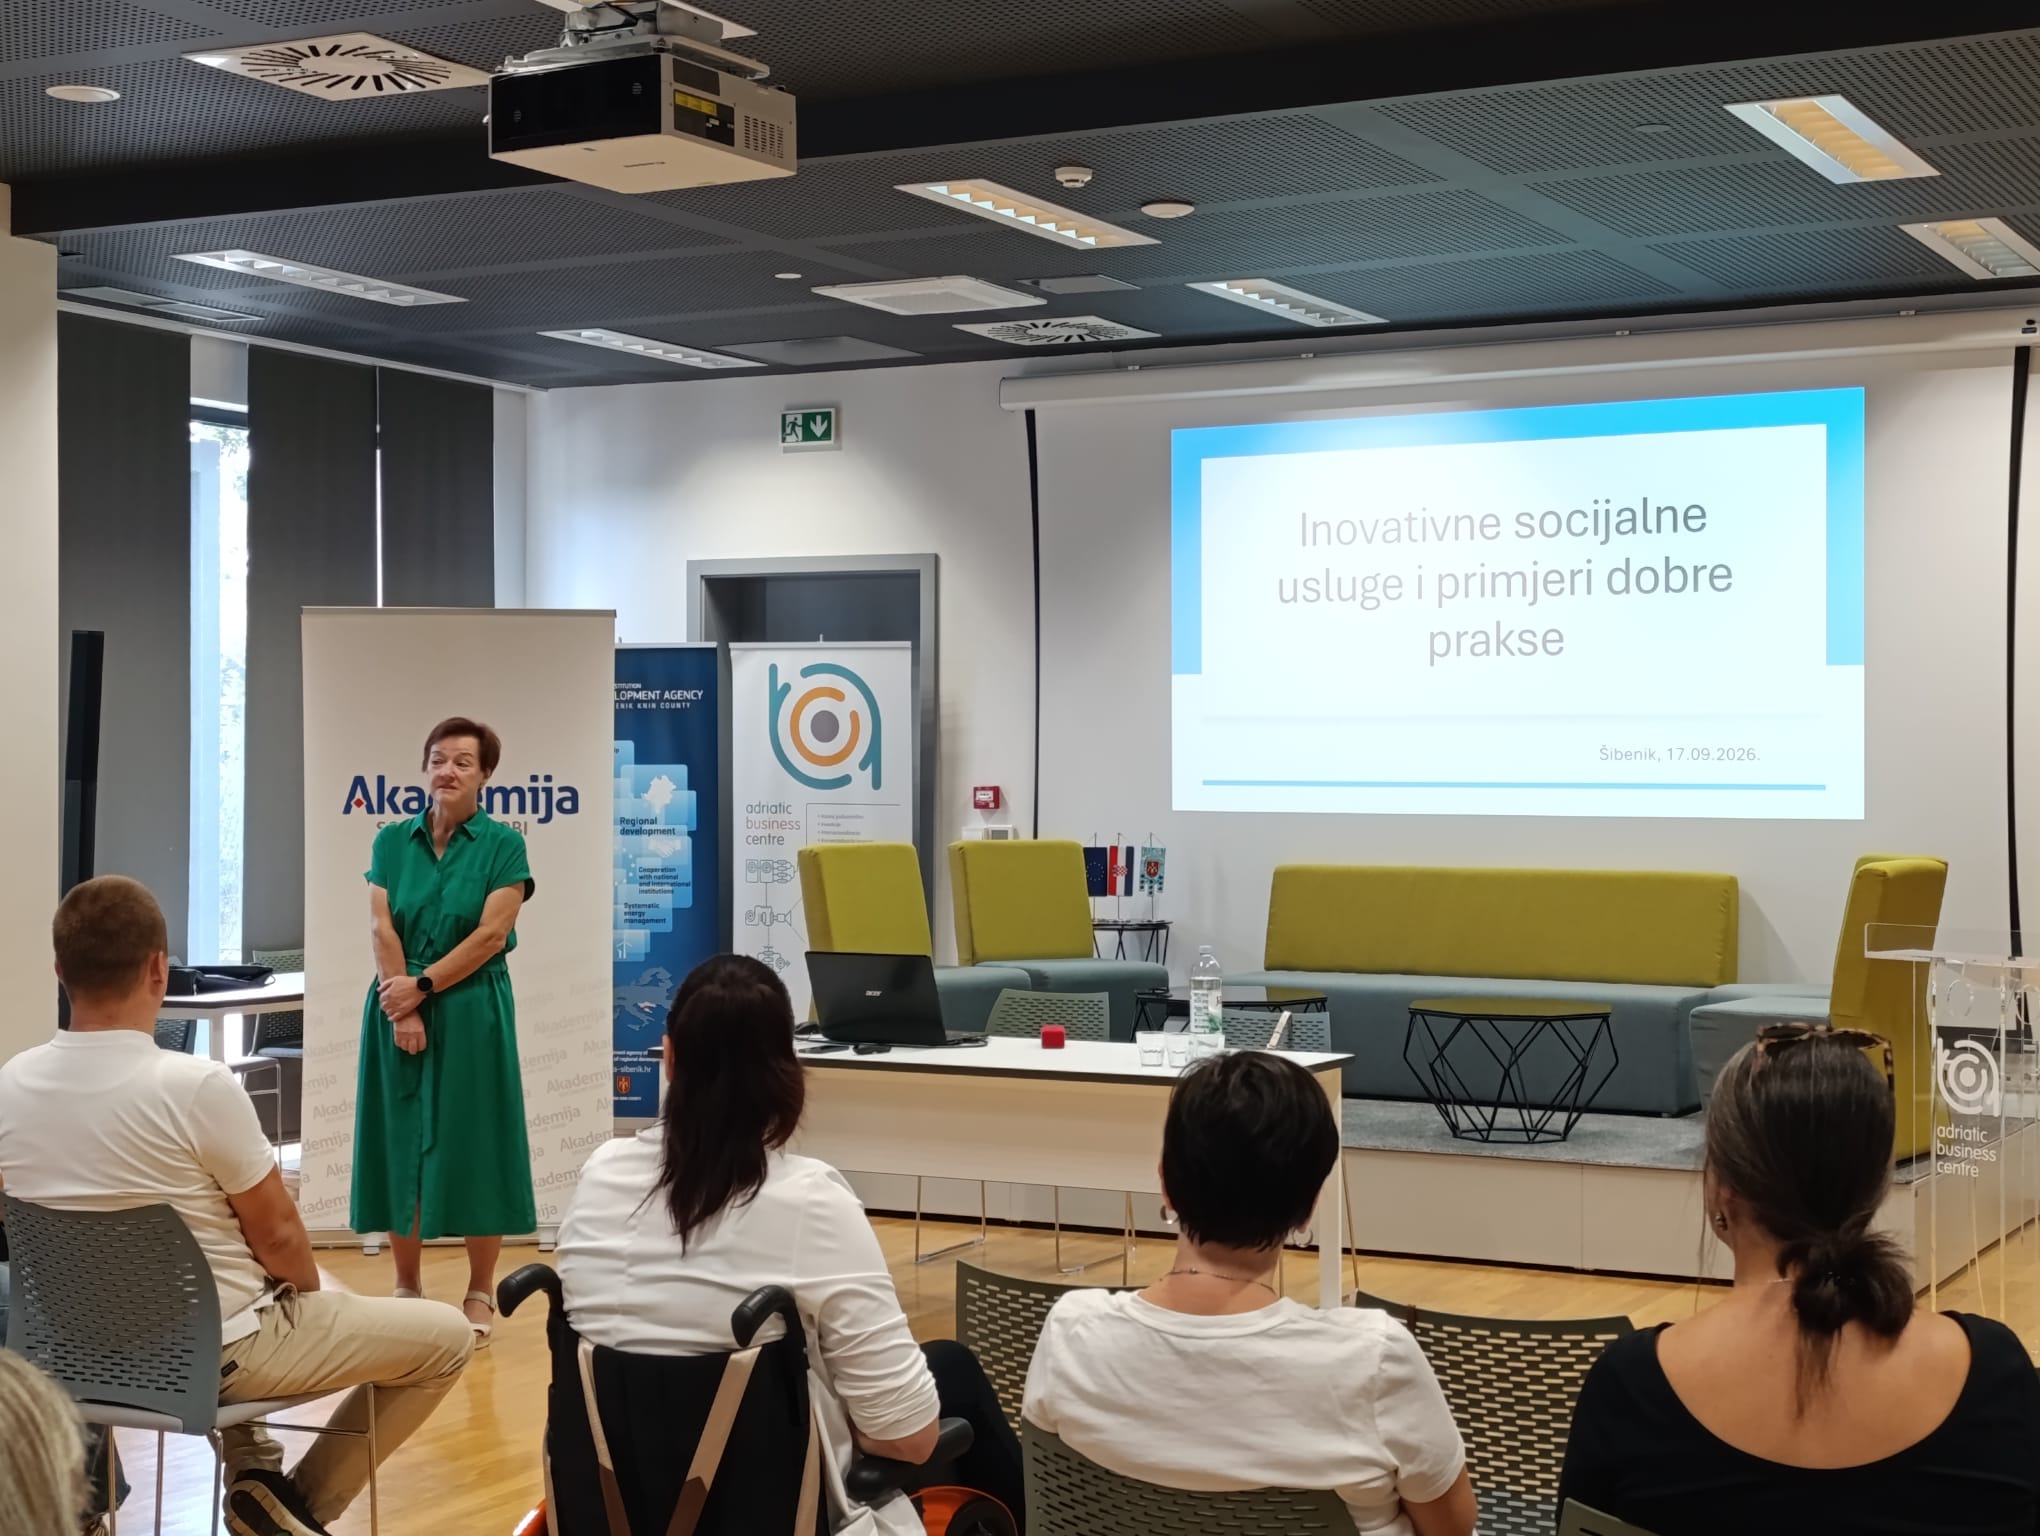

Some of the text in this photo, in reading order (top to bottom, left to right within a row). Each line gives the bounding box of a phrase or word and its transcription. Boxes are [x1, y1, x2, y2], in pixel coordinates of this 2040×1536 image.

[1301, 496, 1707, 547] Inovativne socijalne
[1278, 556, 1734, 611] usluge i primjeri dobre
[1429, 620, 1565, 667] prakse
[614, 689, 704, 701] LOPMENT AGENCY
[1599, 744, 1761, 763] Šibenik, 17.09.2026.
[342, 775, 580, 824] Akamija
[745, 801, 793, 815] adriatic
[619, 816, 658, 827] Regional
[745, 816, 801, 831] business
[619, 827, 676, 837] development
[745, 832, 785, 846] centre
[623, 902, 660, 910] Systematic
[520, 1047, 568, 1069] demija
[546, 1065, 612, 1094] Akademij
[302, 1131, 351, 1152] demija
[560, 1130, 614, 1152] Akadem
[1937, 1123, 1988, 1143] adriatic
[1937, 1140, 1997, 1162] business
[1937, 1161, 1979, 1177] centre
